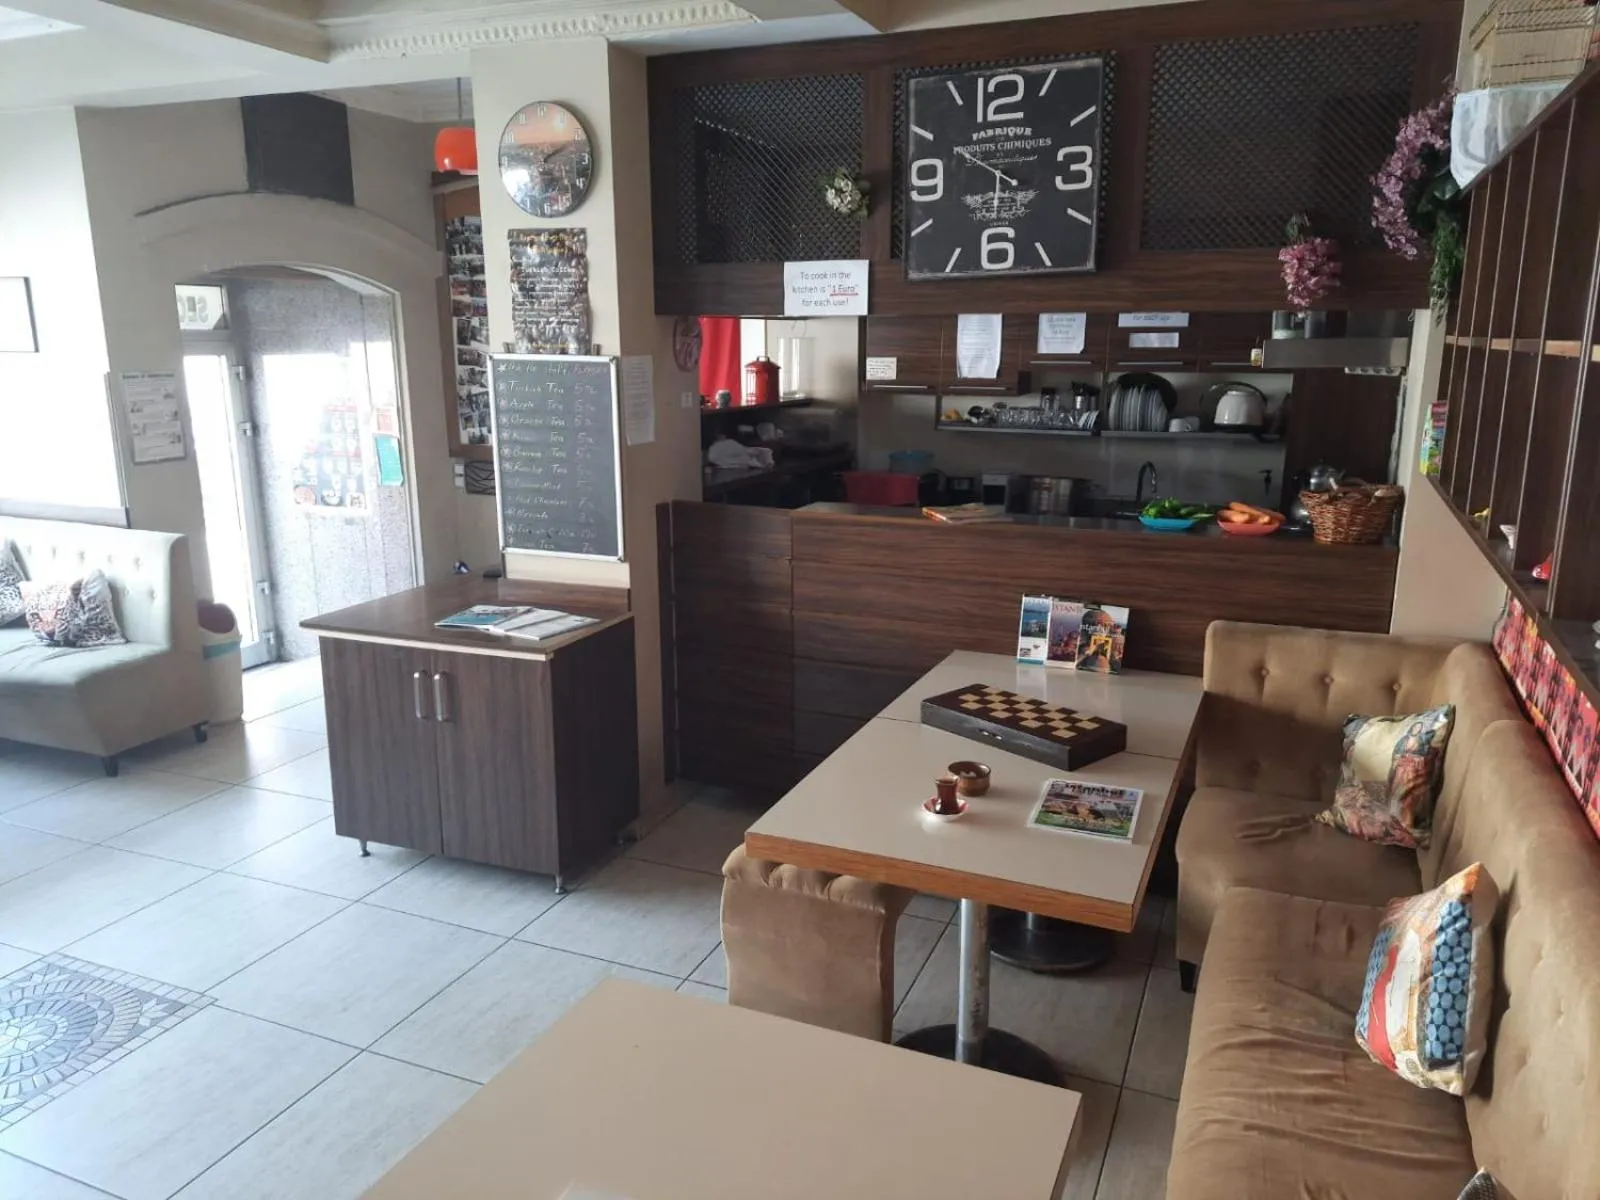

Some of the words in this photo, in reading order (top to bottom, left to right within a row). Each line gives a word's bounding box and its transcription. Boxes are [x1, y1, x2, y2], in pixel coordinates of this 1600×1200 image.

[977, 73, 1025, 123] 12
[972, 127, 1033, 141] FABRIQUE
[953, 144, 996, 156] PRODUITS
[997, 137, 1053, 151] CHIMIQUES
[582, 153, 589, 165] 3
[1055, 145, 1093, 191] 3
[911, 158, 944, 202] 9
[981, 227, 1015, 270] 6
[800, 271, 809, 281] To
[811, 271, 828, 280] cook
[830, 271, 837, 280] in
[838, 271, 851, 280] the
[792, 285, 818, 294] kitchen
[802, 299, 812, 307] for
[814, 299, 830, 307] each
[546, 382, 564, 394] Tea
